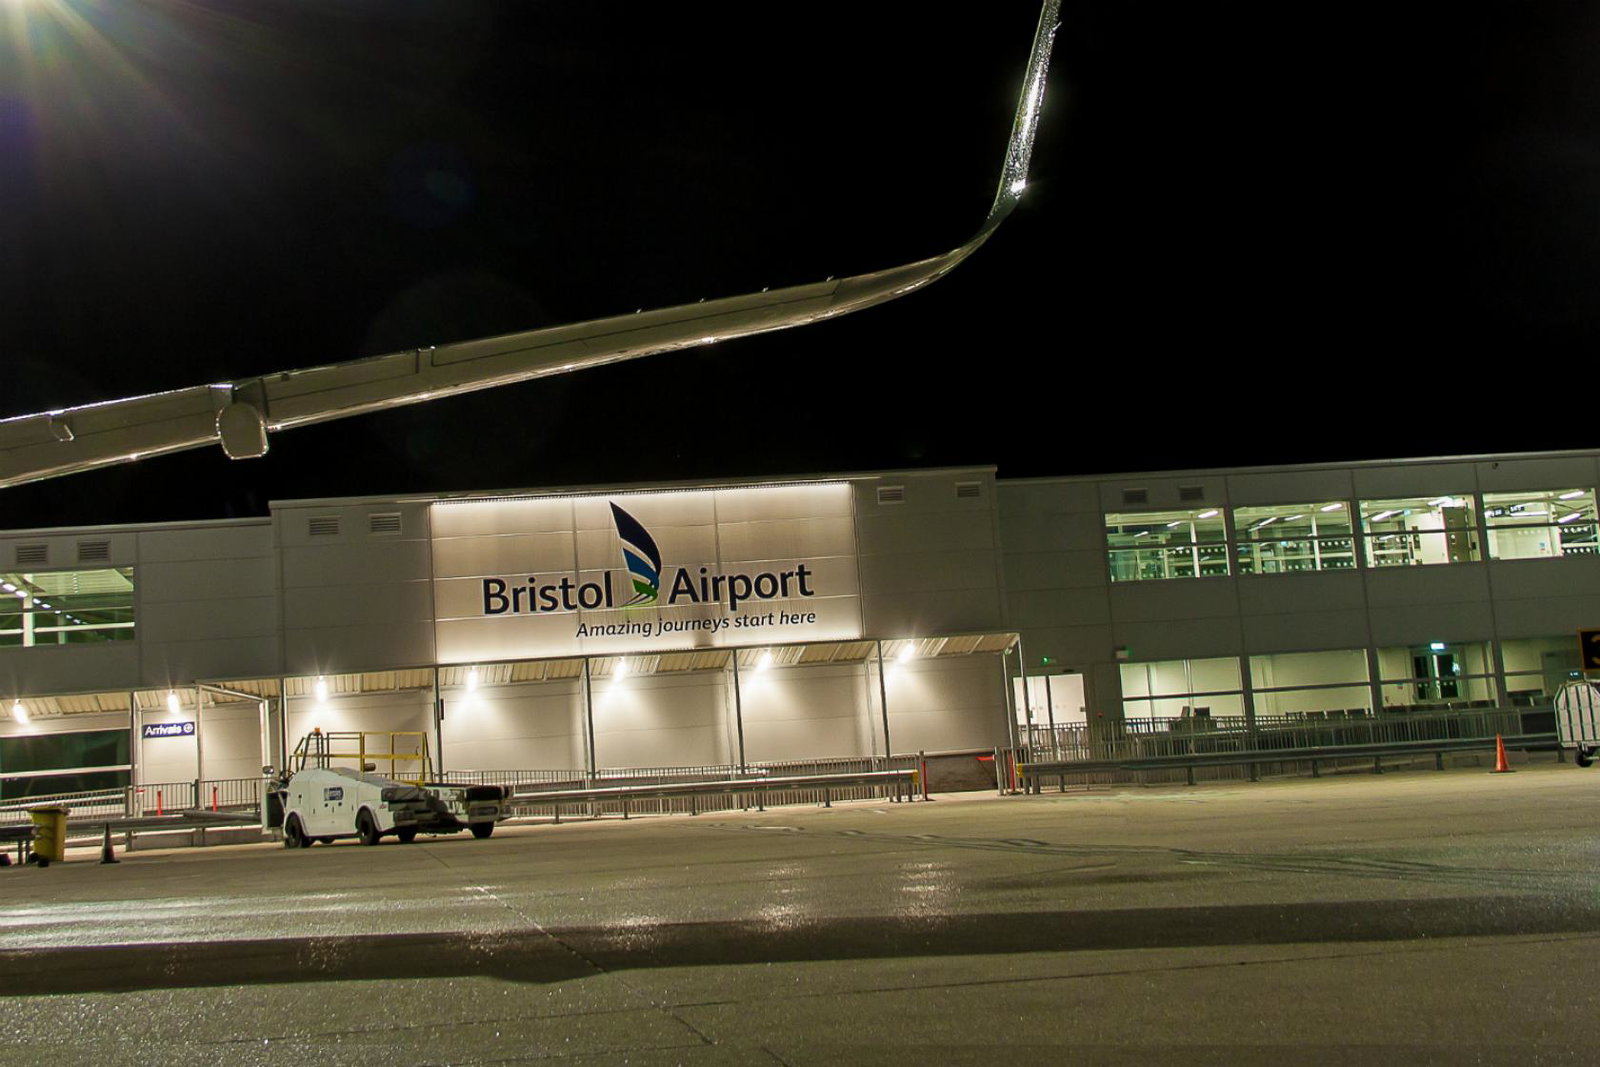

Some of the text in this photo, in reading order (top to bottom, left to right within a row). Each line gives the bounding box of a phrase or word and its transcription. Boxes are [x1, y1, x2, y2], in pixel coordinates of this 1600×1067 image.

[482, 563, 815, 615] Bristol Airport
[576, 610, 816, 638] Amazing journeys start here
[144, 724, 182, 736] Arrivals
